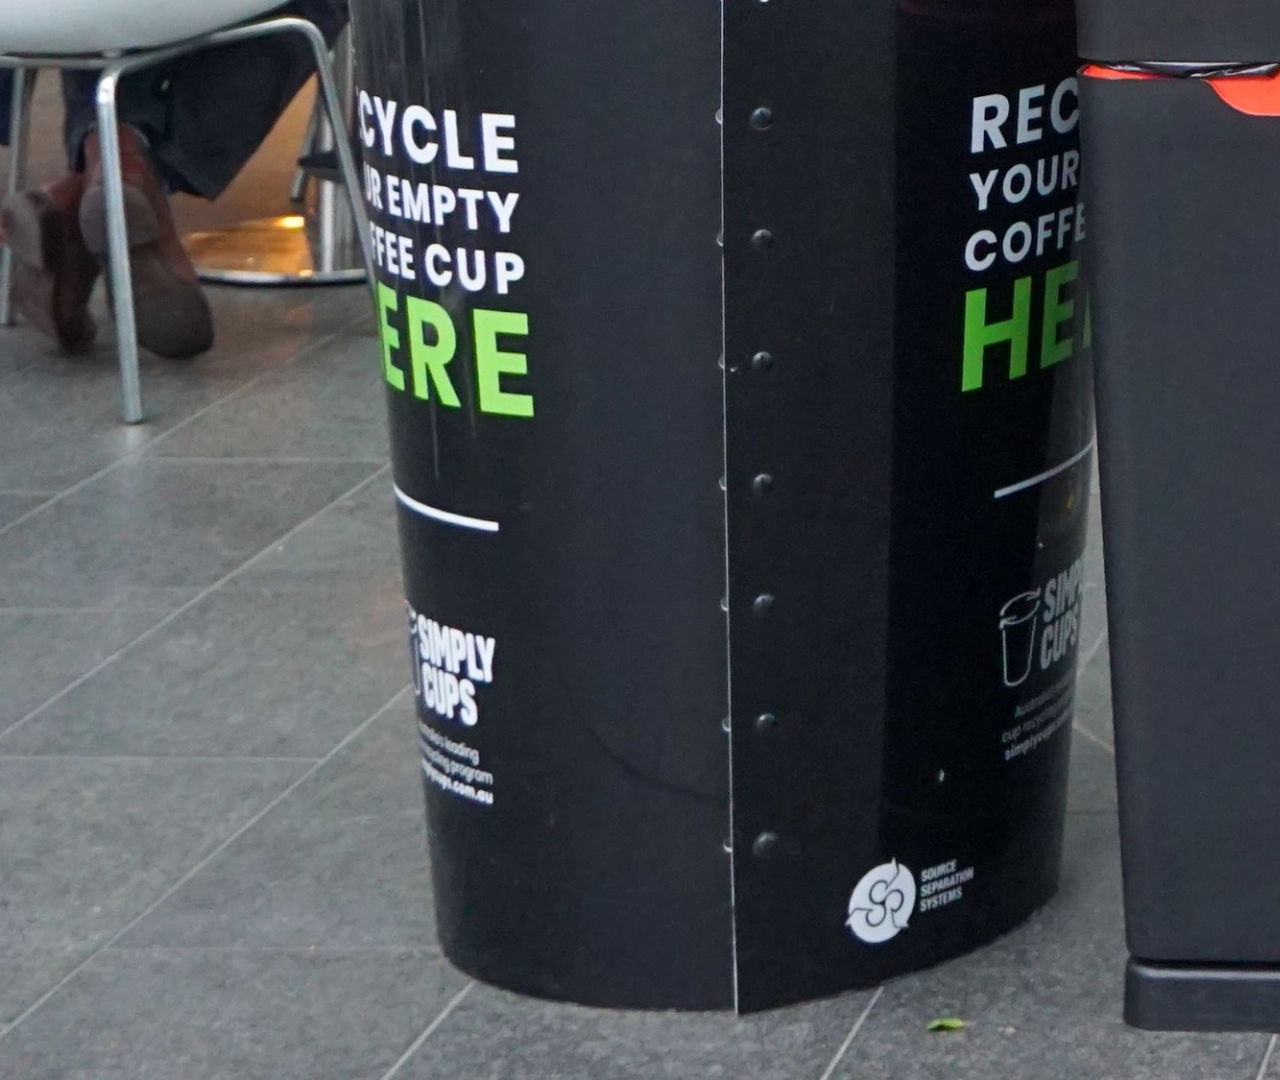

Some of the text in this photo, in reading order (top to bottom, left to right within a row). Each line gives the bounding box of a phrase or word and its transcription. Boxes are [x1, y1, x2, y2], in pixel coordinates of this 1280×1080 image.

[386, 174, 519, 233] EMPTY
[424, 243, 525, 294] CUP
[417, 614, 495, 683] SIMPLY
[421, 662, 478, 727] CUPS
[921, 859, 958, 882] SOURCE
[921, 867, 975, 897] SEPARATION
[920, 886, 963, 912] SYSTEMS
